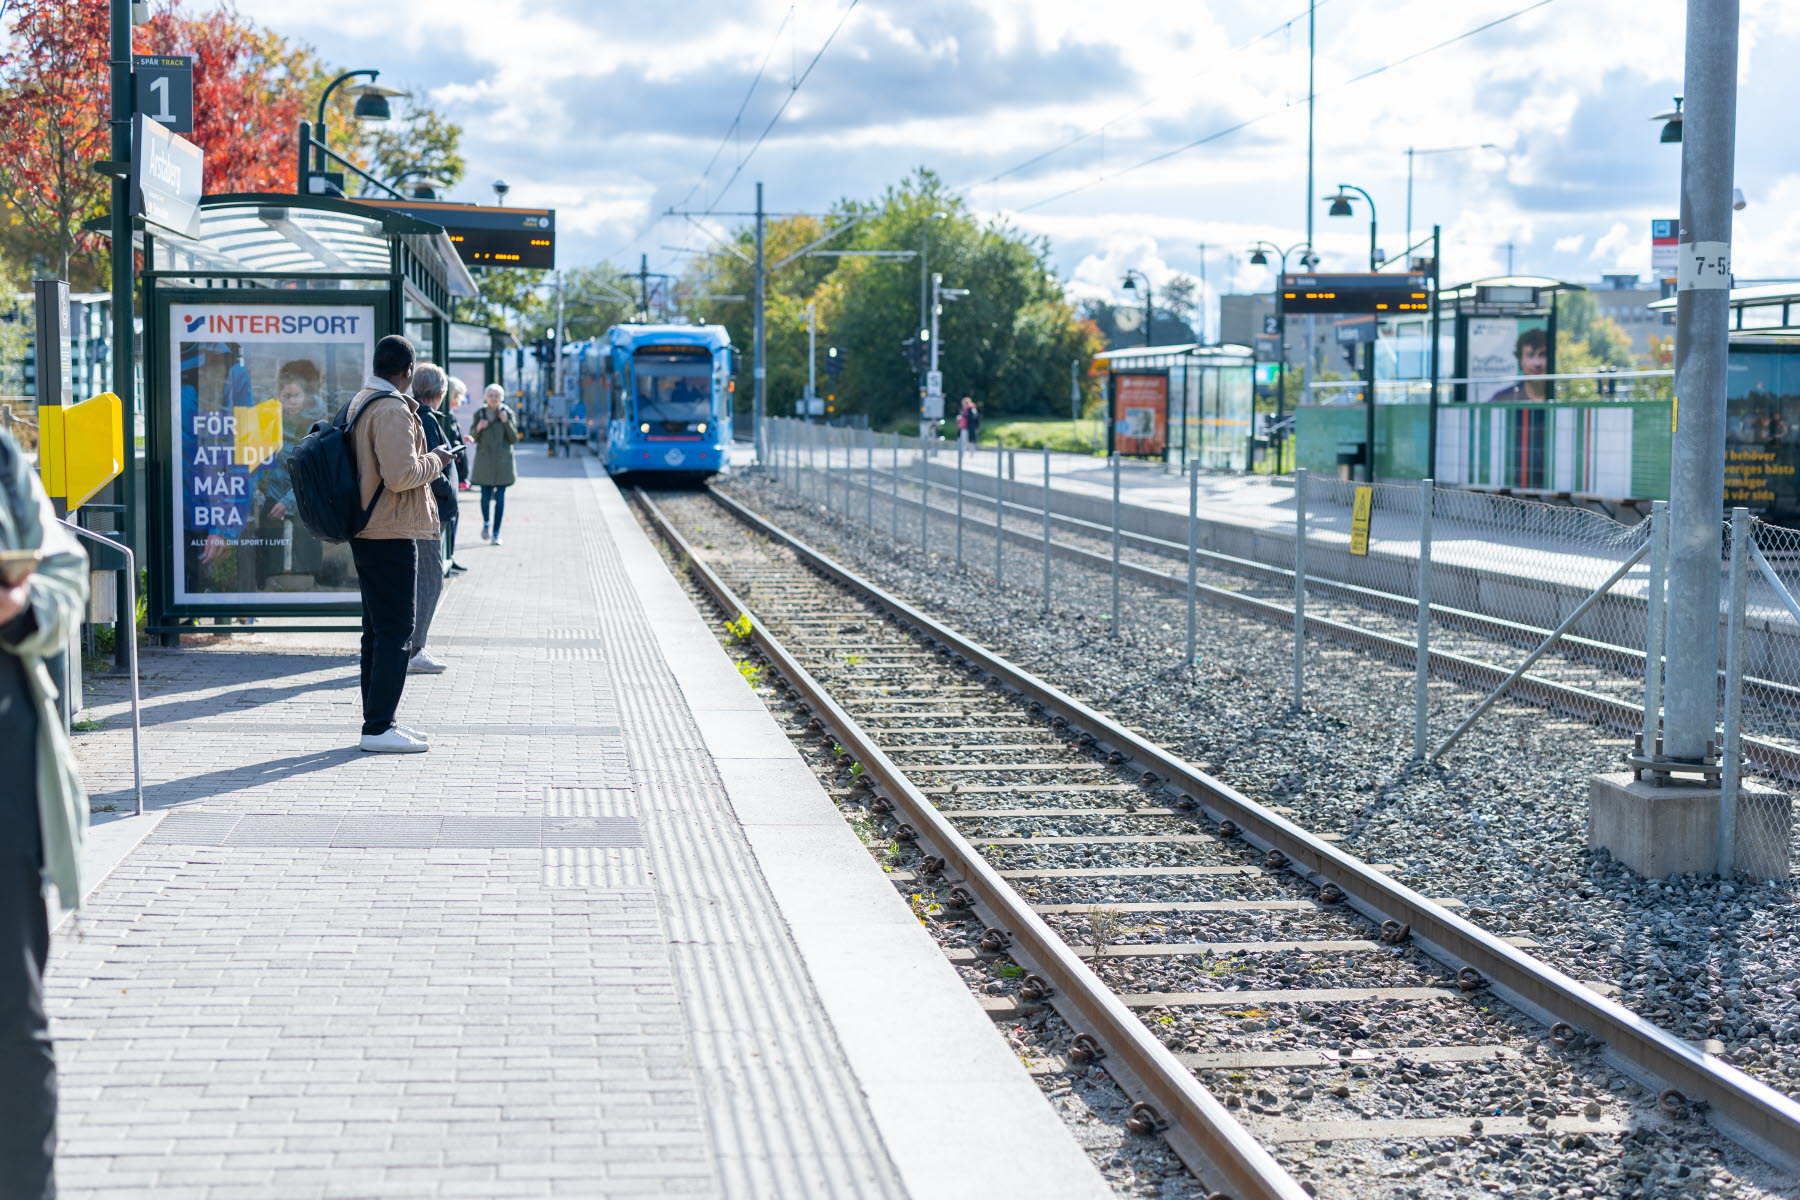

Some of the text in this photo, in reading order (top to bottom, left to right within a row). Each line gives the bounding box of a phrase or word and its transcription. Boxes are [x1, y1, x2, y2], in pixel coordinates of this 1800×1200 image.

[150, 77, 176, 122] 1
[209, 315, 359, 334] INTERSPORT
[193, 411, 237, 435] FÖR
[193, 447, 274, 465] ATT DU
[1764, 464, 1795, 474] bästa
[194, 472, 245, 495] MÅR
[195, 507, 243, 526] BRA
